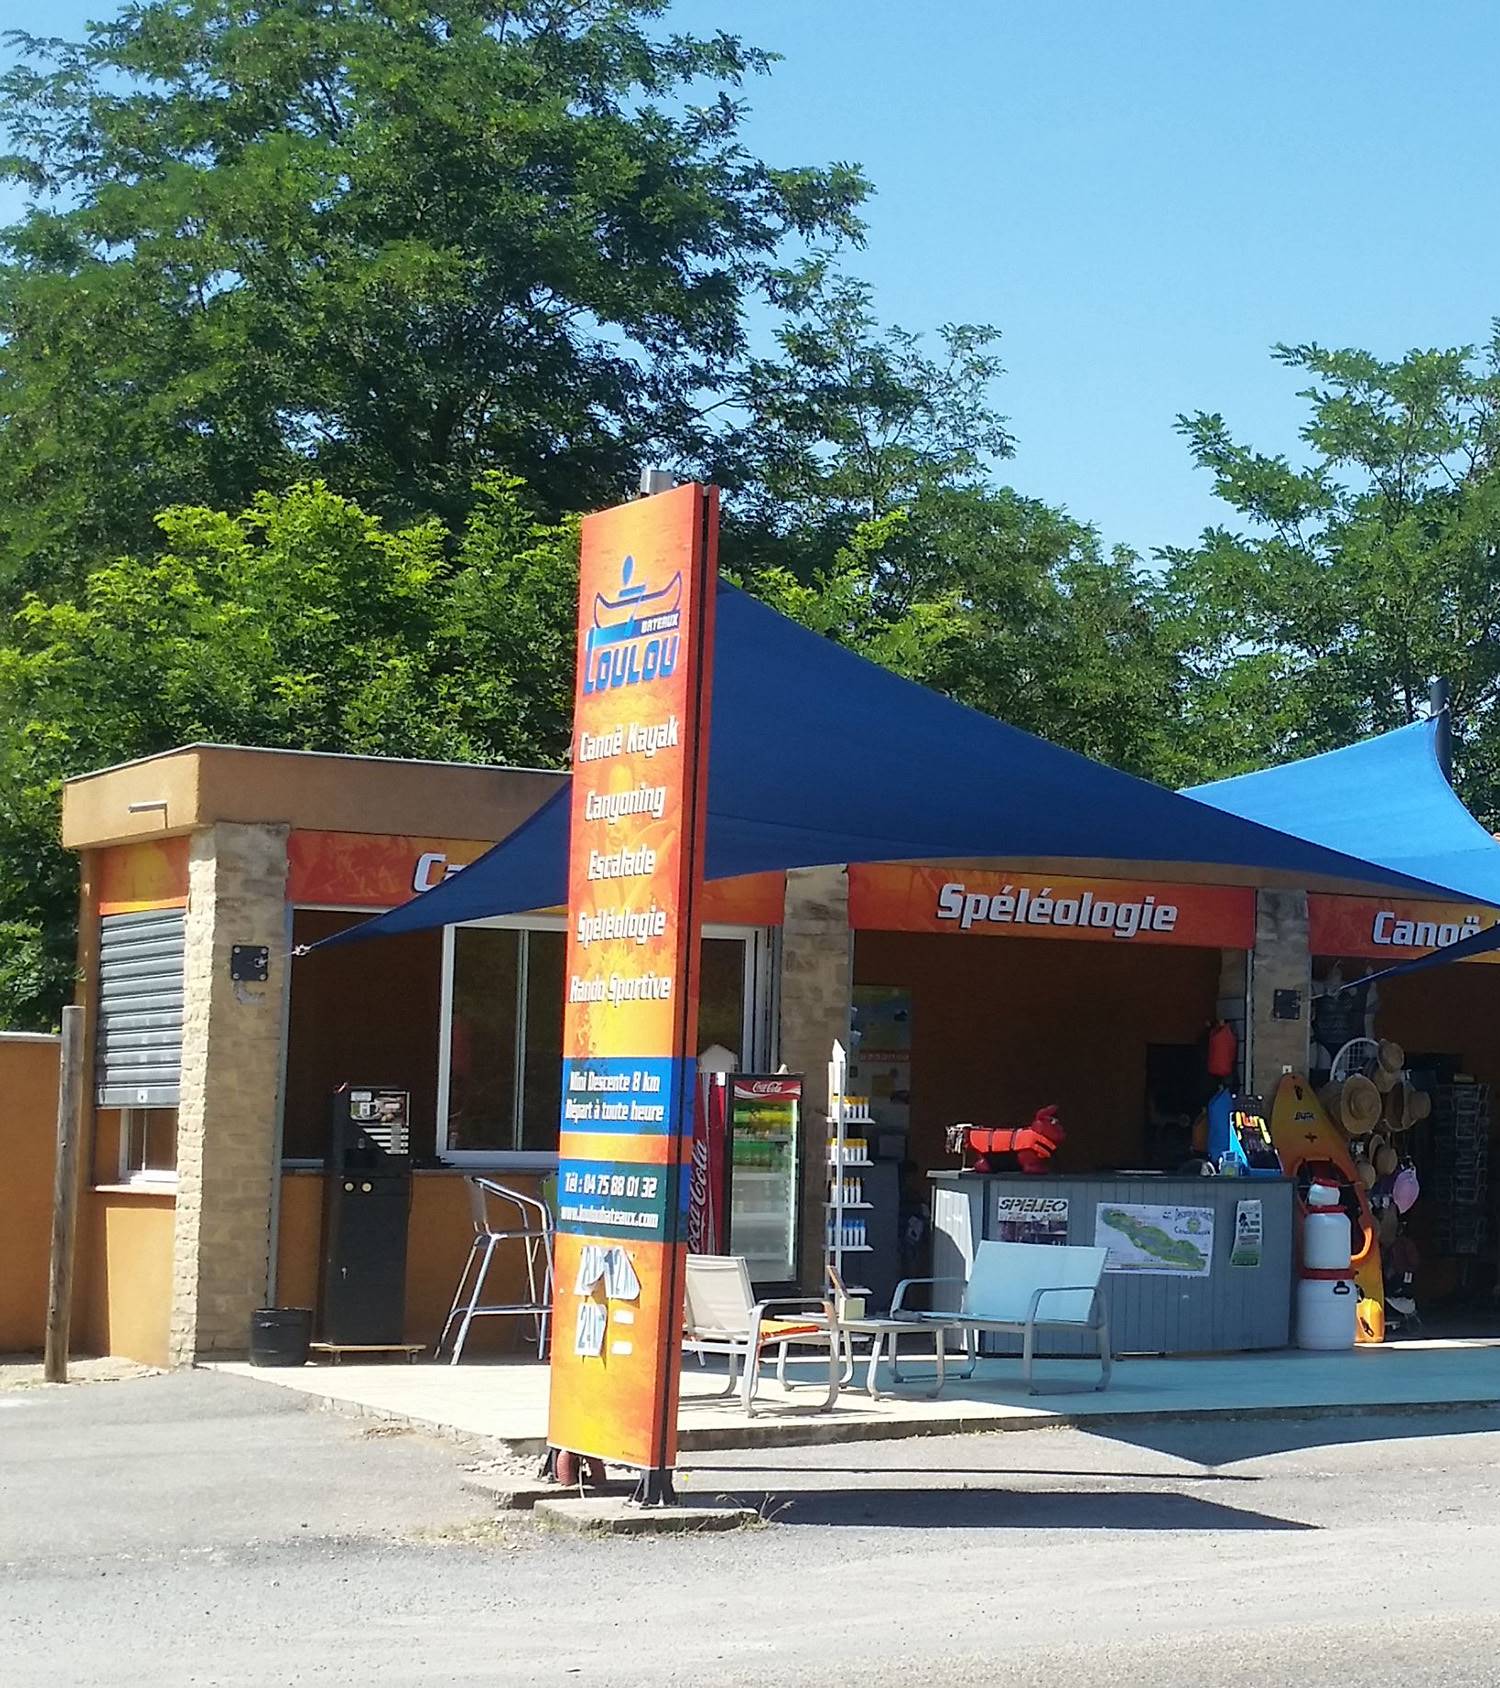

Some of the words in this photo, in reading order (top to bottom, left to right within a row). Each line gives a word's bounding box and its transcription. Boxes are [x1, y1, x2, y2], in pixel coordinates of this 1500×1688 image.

[583, 628, 680, 696] LOULOU
[579, 723, 624, 763] Canoë
[627, 716, 680, 759] Kayak
[585, 782, 666, 824] Canyoning
[587, 843, 657, 881] Escalade
[577, 904, 667, 949] Spéléologie
[937, 882, 1179, 938] Spéléologie
[569, 975, 607, 1003] Rando
[607, 972, 673, 1008] Sportive
[587, 1072, 630, 1092] Descente
[632, 1070, 641, 1092] 8
[565, 1098, 593, 1124] Départ
[601, 1102, 629, 1121] toute
[630, 1100, 664, 1122] heure
[583, 1174, 596, 1194] 04
[597, 1175, 610, 1195] 75
[611, 1175, 625, 1196] 88
[626, 1177, 639, 1197] 01
[640, 1177, 658, 1199] 32
